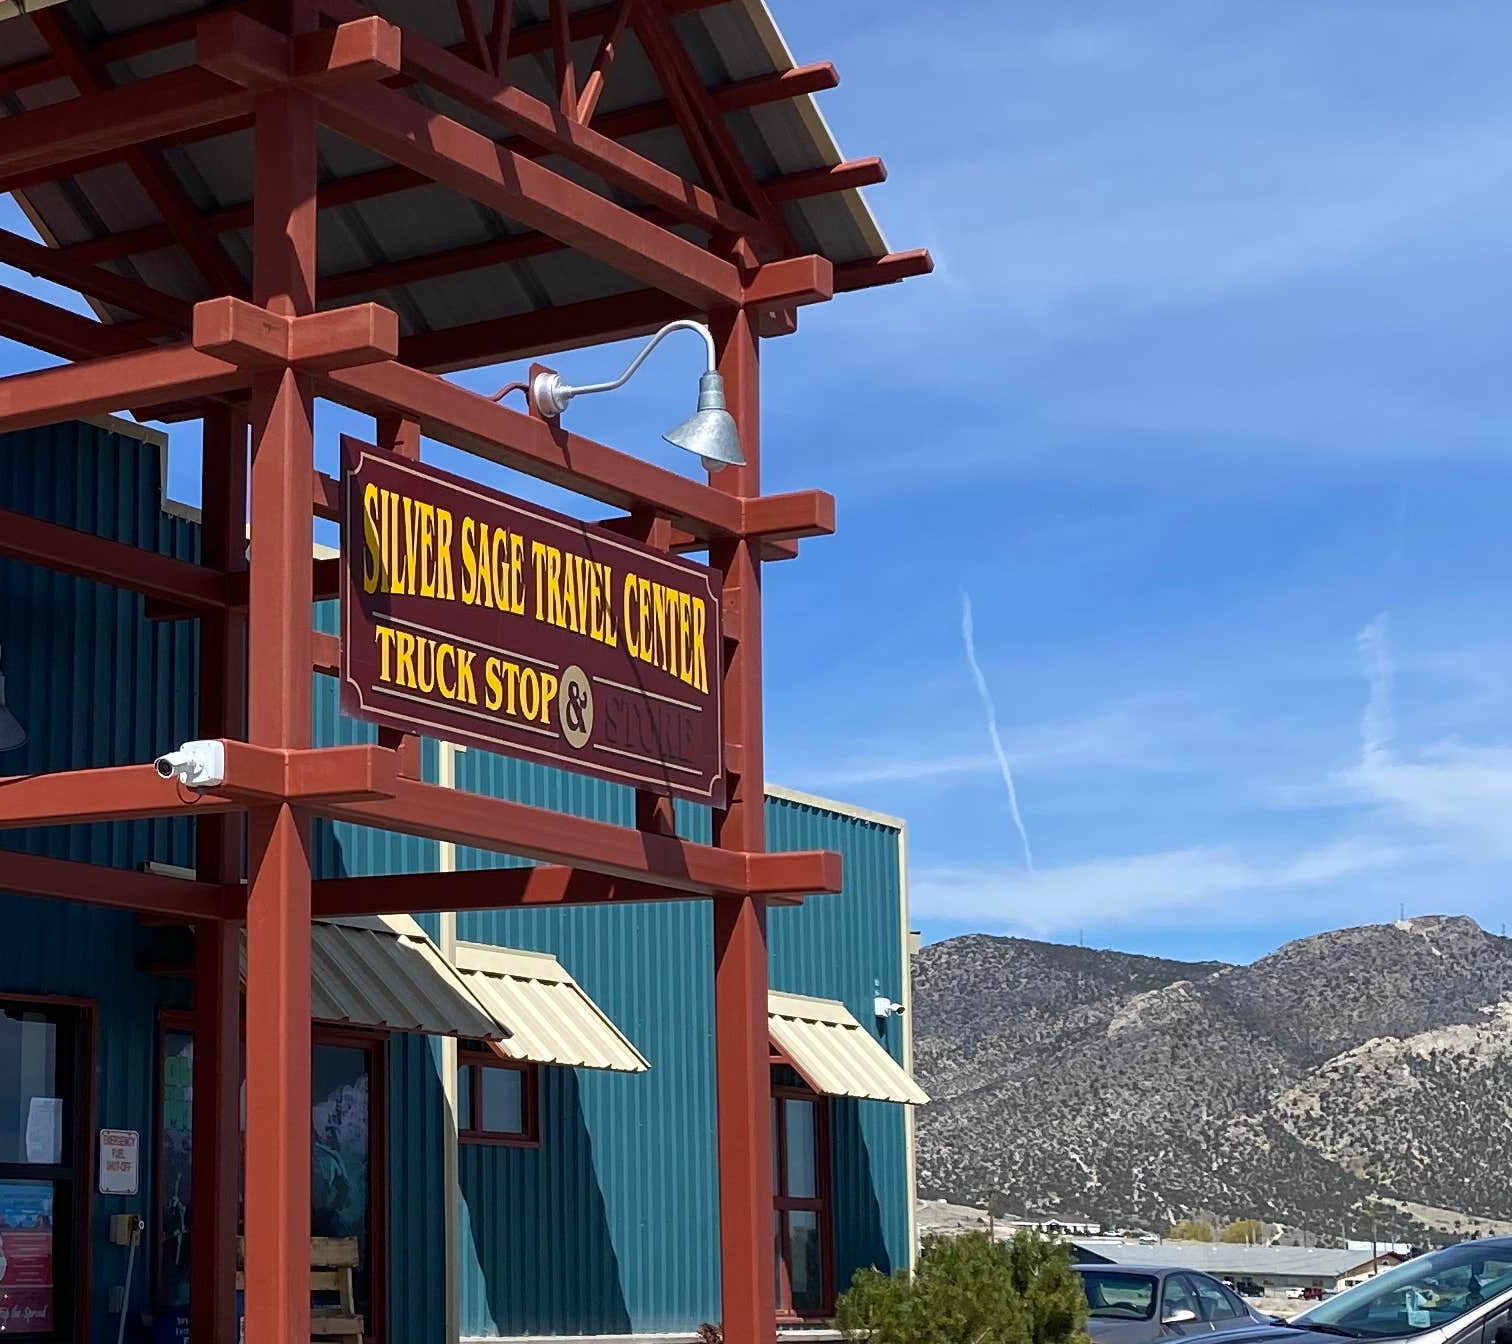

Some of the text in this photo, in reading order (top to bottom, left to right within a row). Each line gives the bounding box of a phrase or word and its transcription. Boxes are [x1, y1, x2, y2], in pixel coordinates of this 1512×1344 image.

[363, 482, 709, 695] SILVER SAGE TRAVEL CENTER
[375, 625, 477, 705] TRUCK
[485, 657, 558, 725] STOP
[566, 680, 587, 734] &
